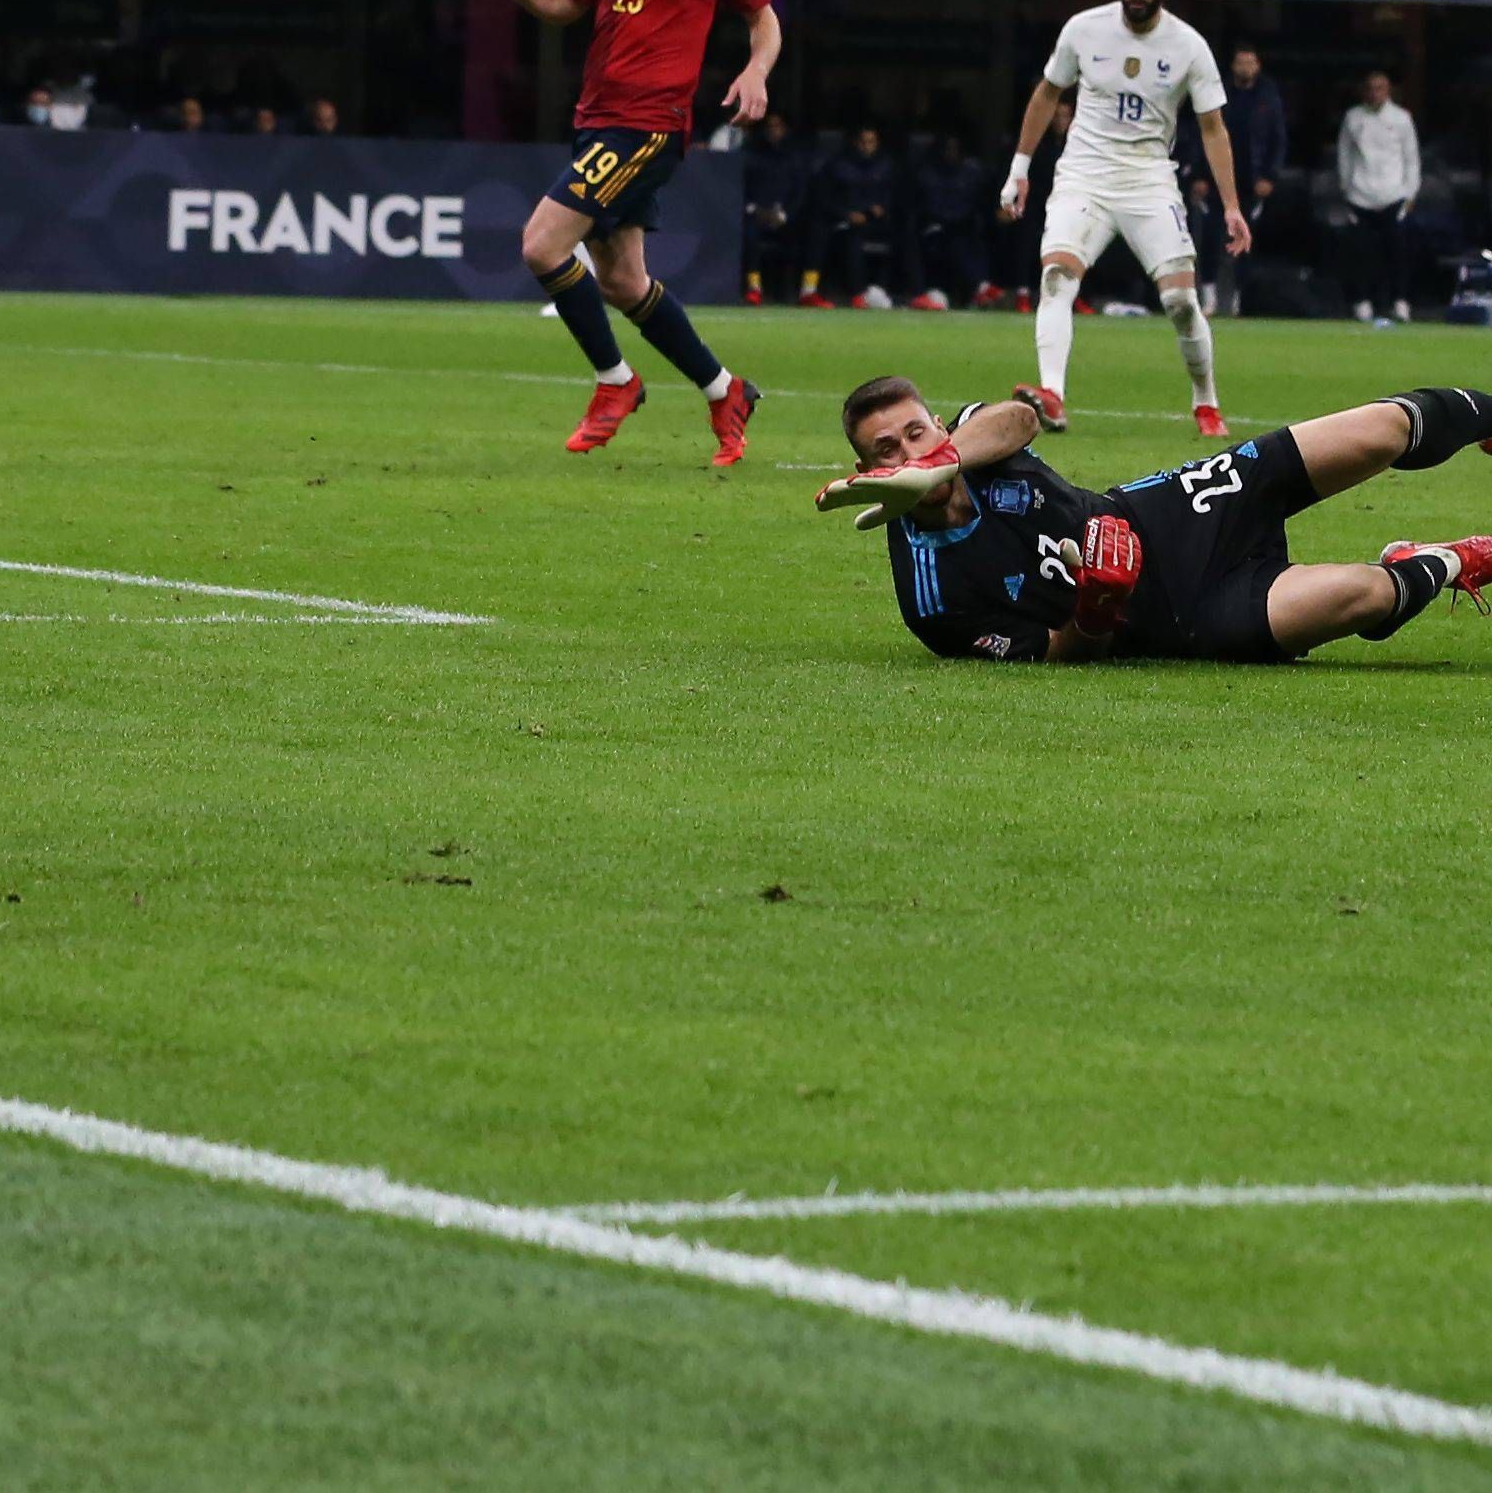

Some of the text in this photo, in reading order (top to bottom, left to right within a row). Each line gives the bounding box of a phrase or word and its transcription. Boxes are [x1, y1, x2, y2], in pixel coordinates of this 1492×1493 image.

[1117, 92, 1144, 121] 19
[572, 142, 619, 185] 19
[168, 189, 464, 258] FRANCE
[1179, 453, 1243, 514] 23
[1084, 518, 1100, 568] reusch
